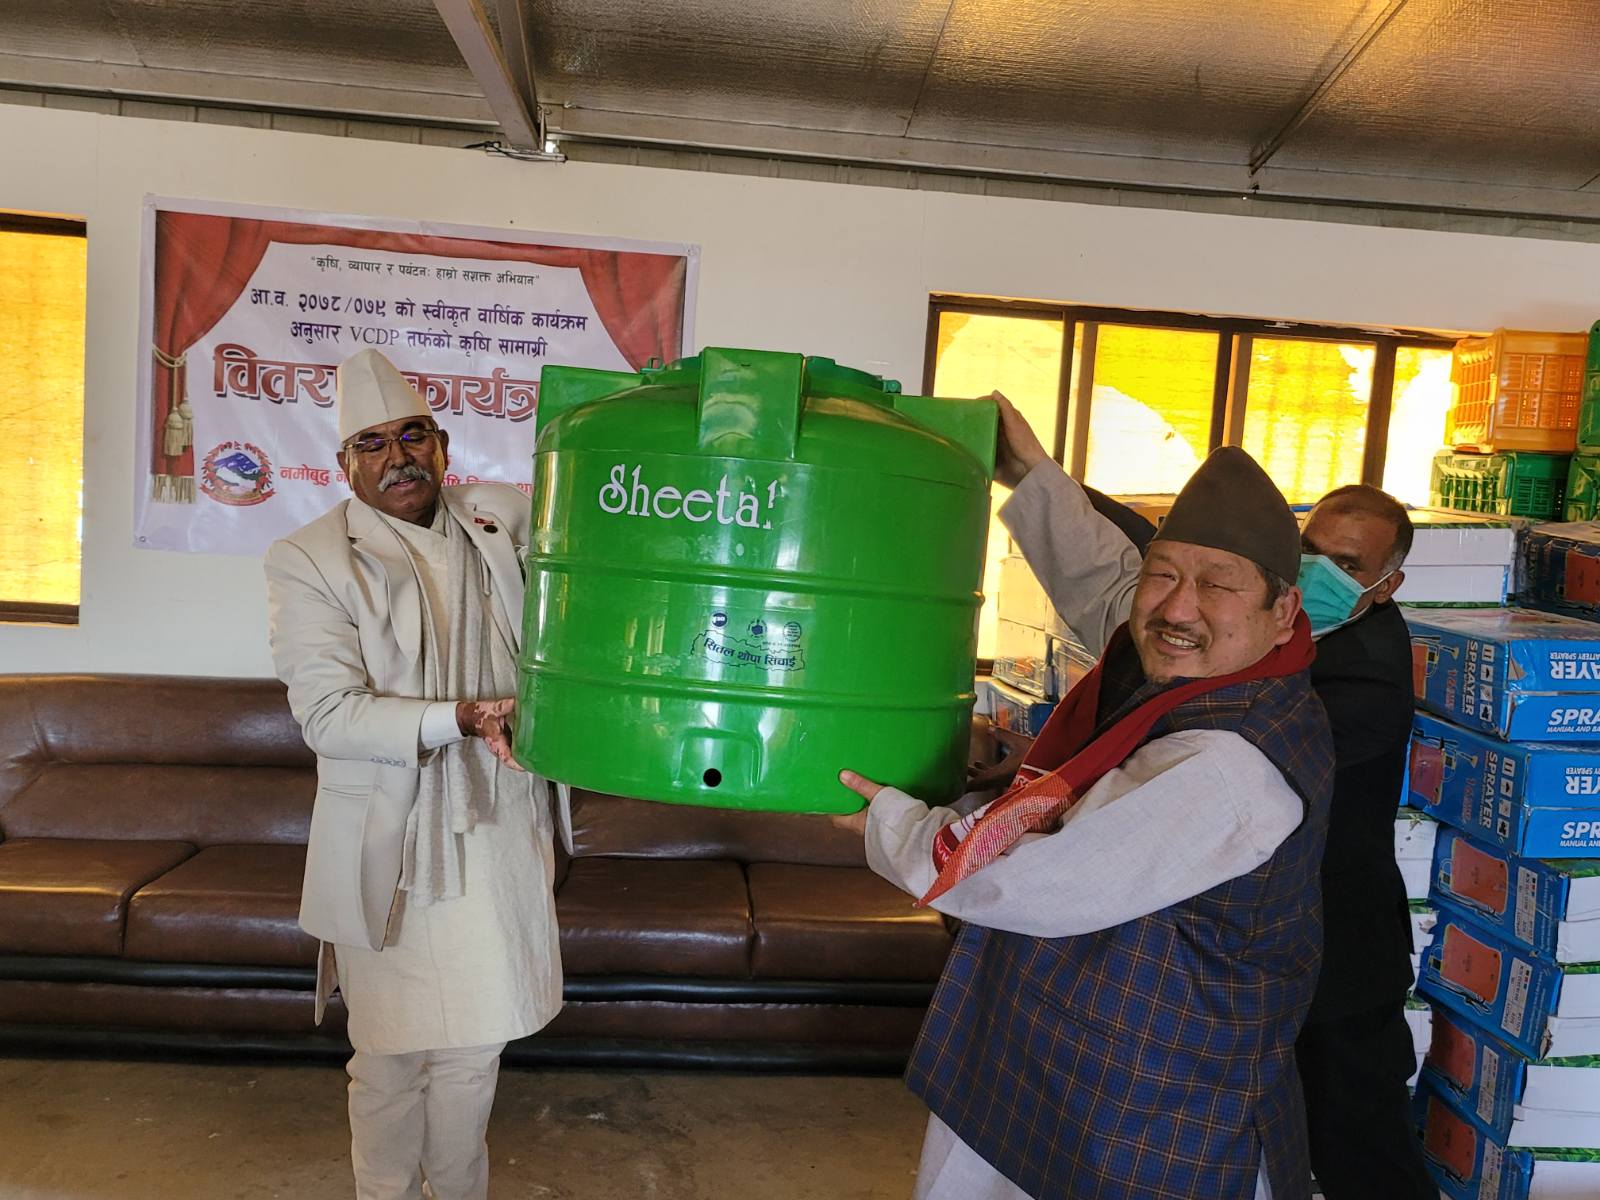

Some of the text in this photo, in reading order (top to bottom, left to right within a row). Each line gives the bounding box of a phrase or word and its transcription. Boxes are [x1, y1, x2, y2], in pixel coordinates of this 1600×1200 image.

[348, 260, 381, 274] व्यापार
[386, 263, 396, 276] र
[436, 267, 458, 280] हाम्रो
[462, 270, 492, 283] सशक्त
[395, 298, 416, 318] को
[422, 300, 471, 327] स्वीकृत
[478, 304, 526, 326] वार्षिक
[531, 309, 589, 331] कार्यक्रम
[290, 321, 549, 357] अनुसार VCDP तर्फको कृषि सामाग्री
[212, 343, 338, 408] वितर
[279, 464, 331, 487] नमोबुद्ध
[598, 463, 778, 530] Sheetal
[703, 637, 735, 657] सितल
[737, 649, 761, 664] थोपा
[1465, 639, 1478, 716] SPRAYER
[1546, 725, 1575, 733] MANUAL
[1575, 725, 1591, 733] AND
[1482, 751, 1498, 829] SPRAYER
